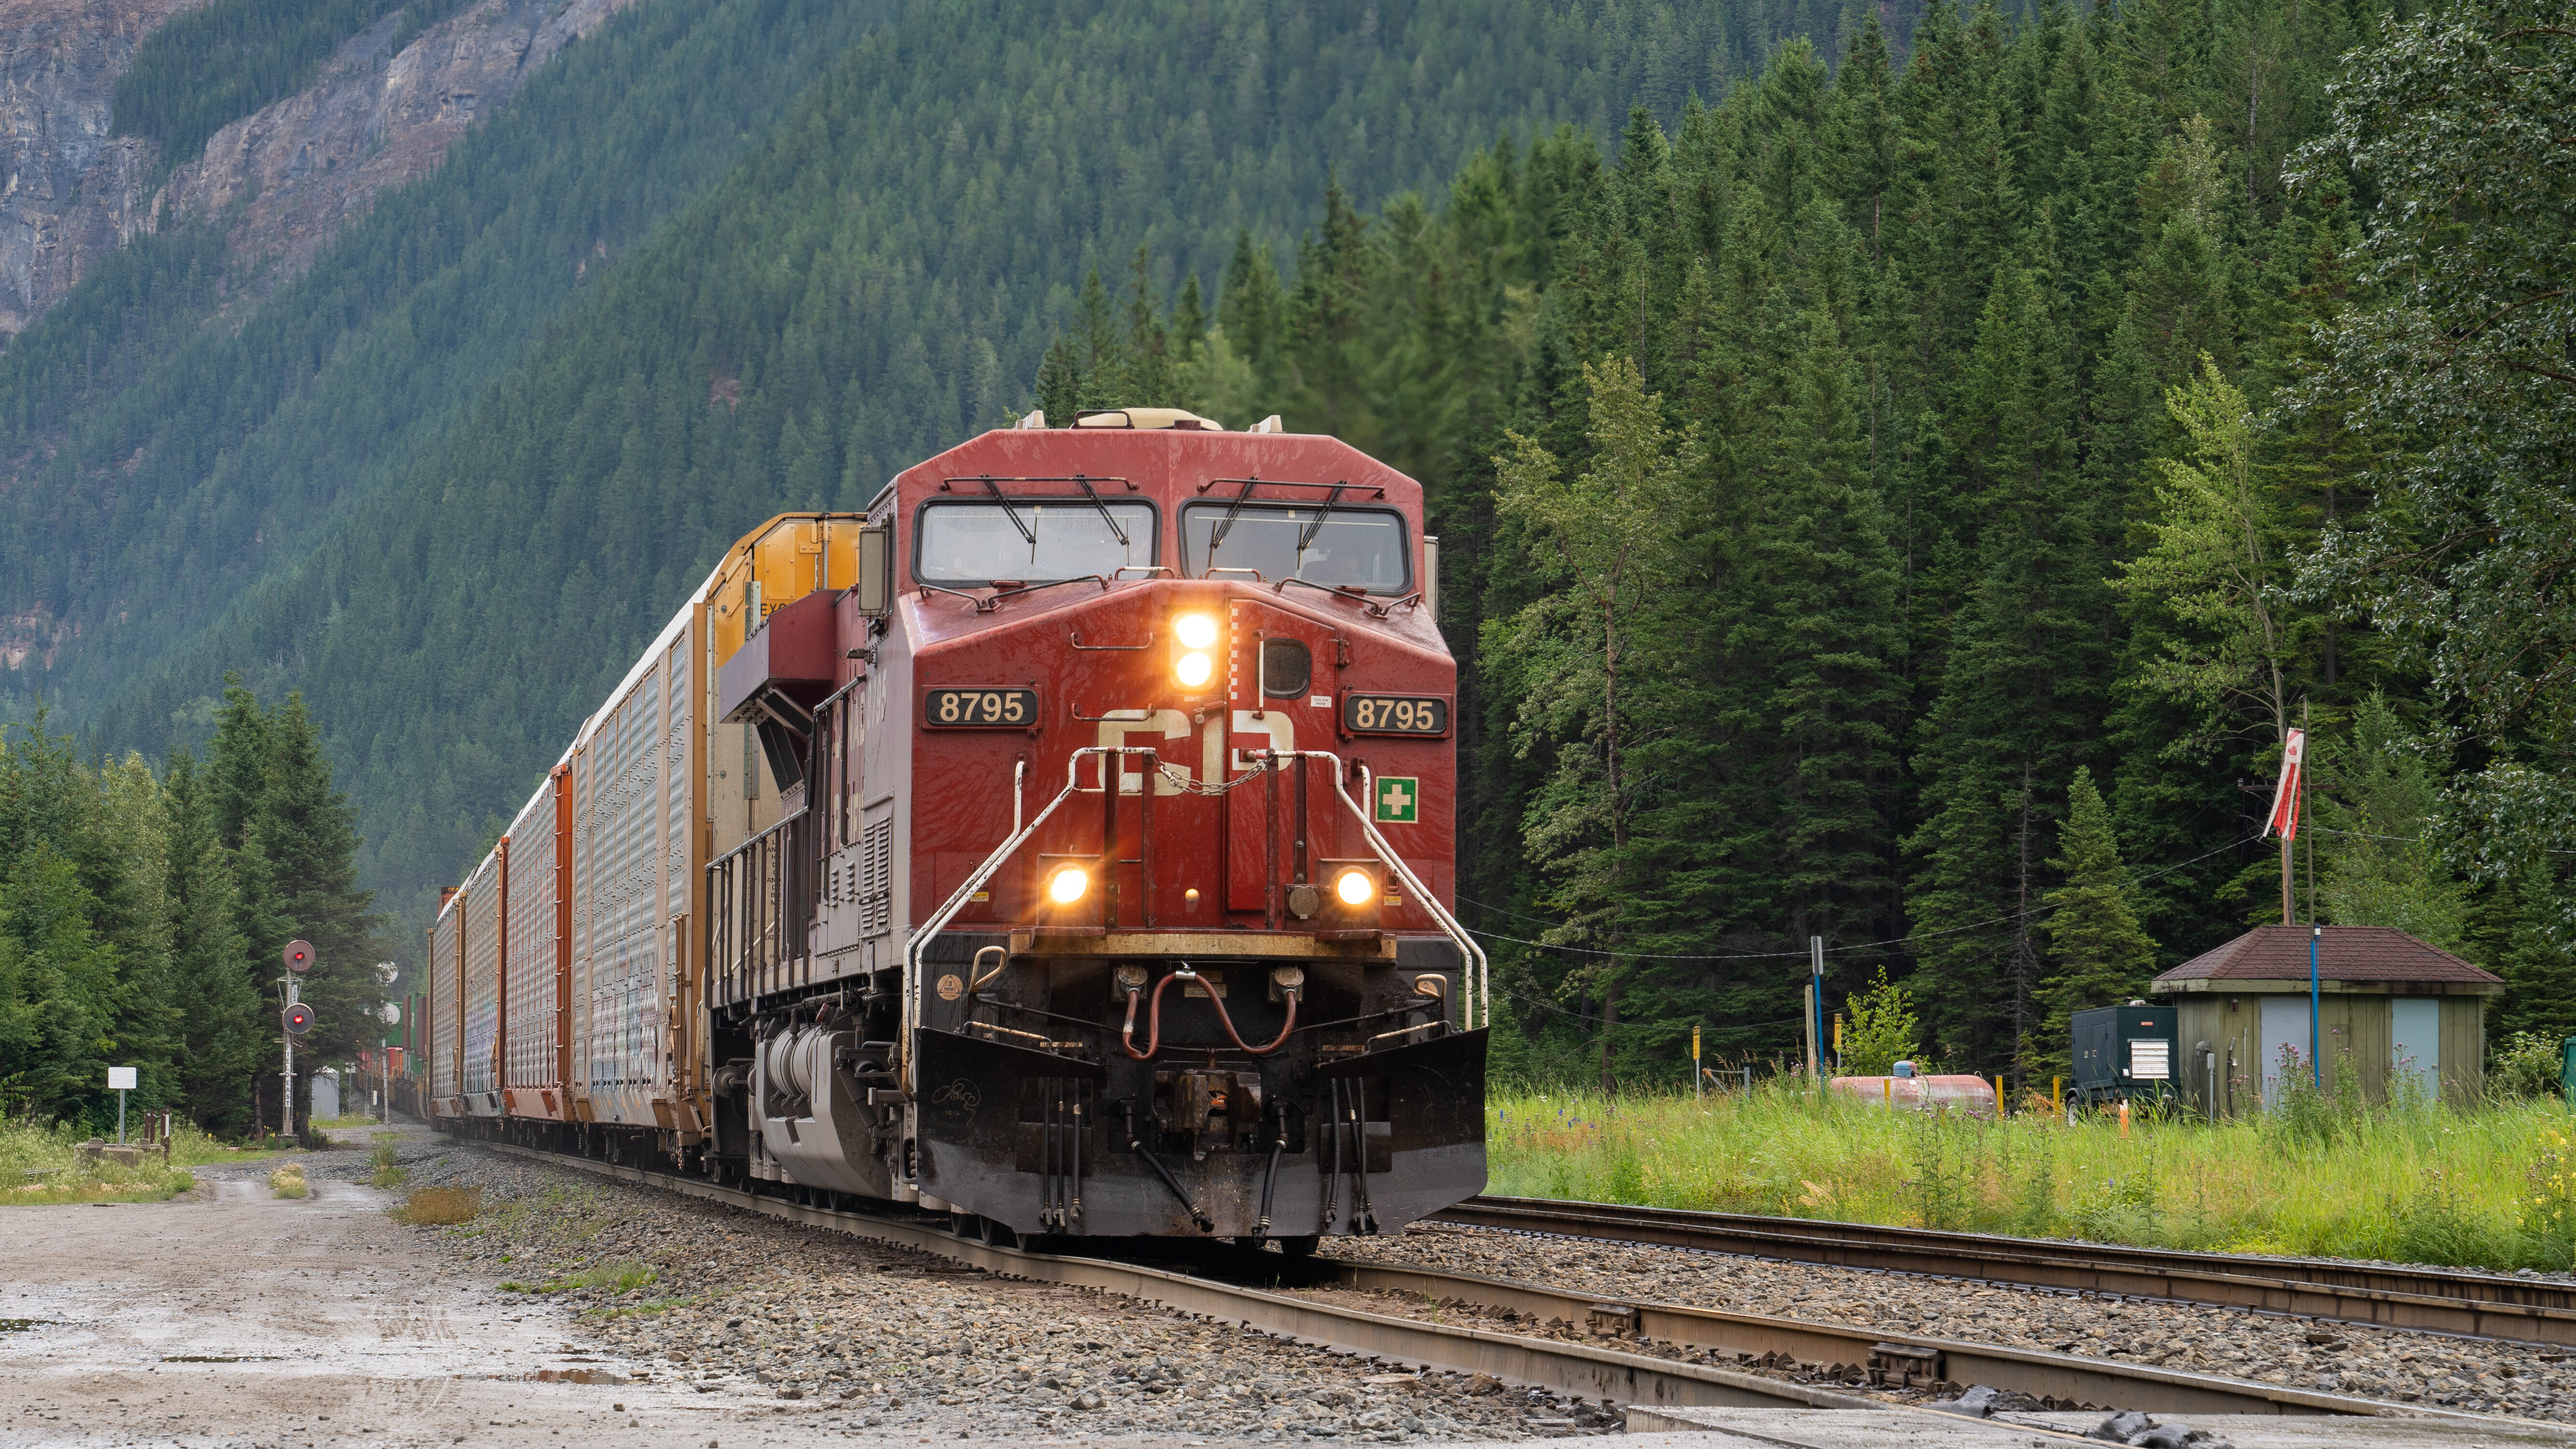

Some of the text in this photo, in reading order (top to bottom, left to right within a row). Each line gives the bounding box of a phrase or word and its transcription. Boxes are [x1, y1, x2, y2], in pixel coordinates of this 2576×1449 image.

[867, 668, 887, 731] 8795
[940, 693, 1023, 722] 8795
[1357, 699, 1434, 730] 8795
[1098, 709, 1294, 796] CP
